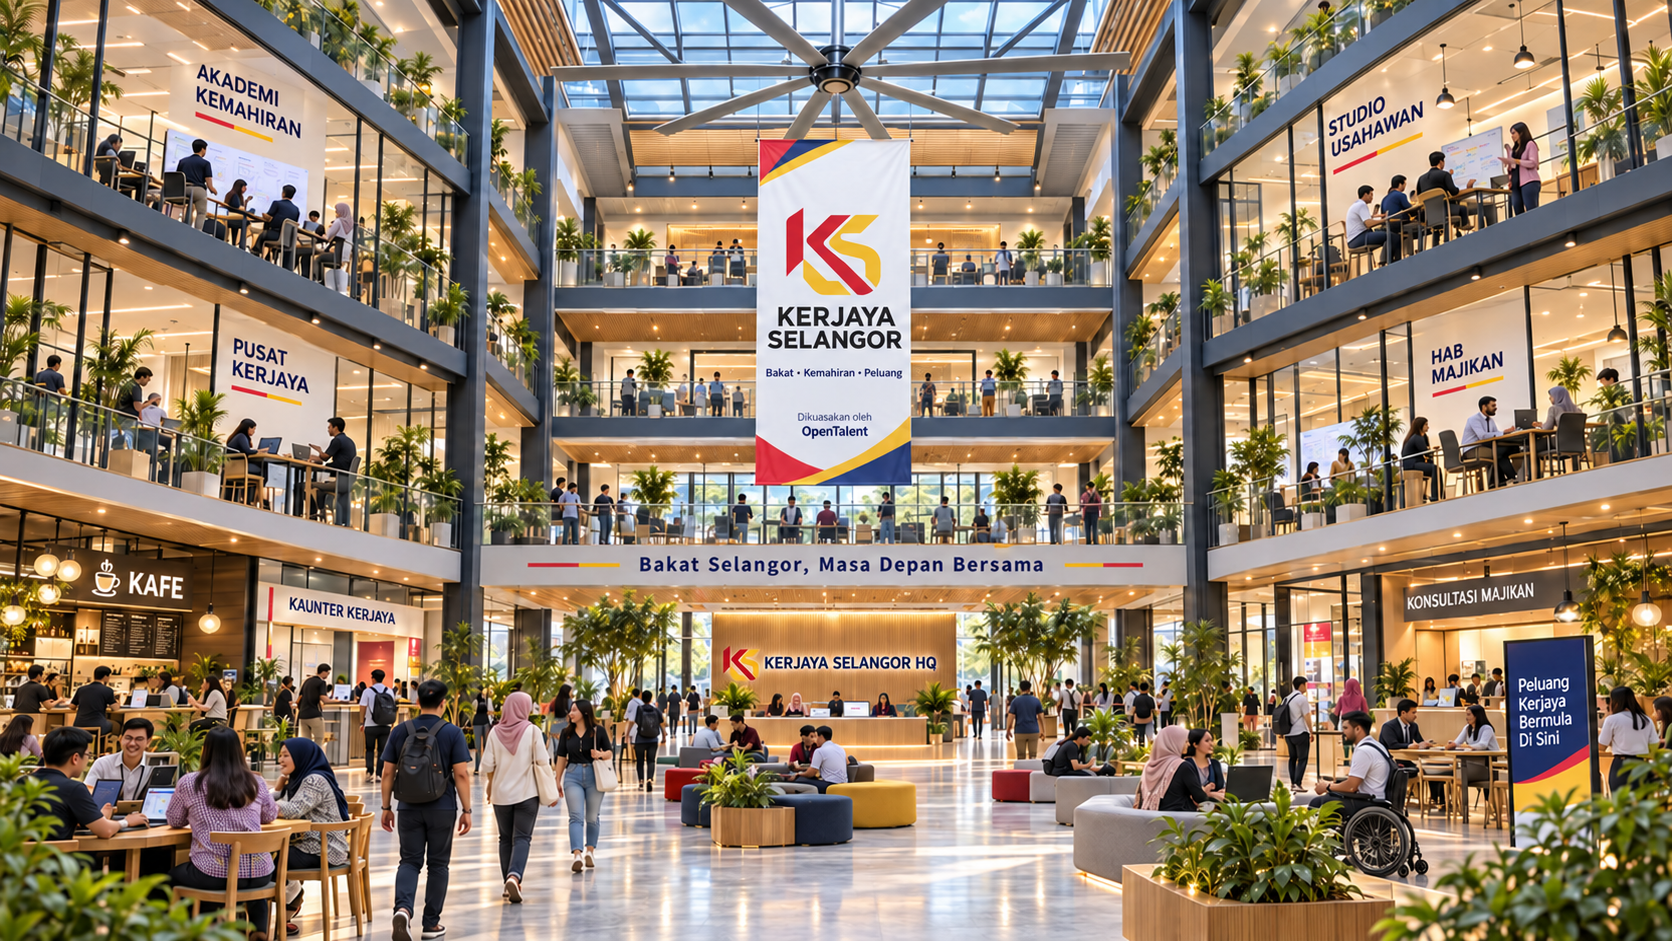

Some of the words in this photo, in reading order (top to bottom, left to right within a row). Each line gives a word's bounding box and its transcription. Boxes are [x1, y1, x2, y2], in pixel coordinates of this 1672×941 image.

[197, 64, 279, 107] AKADEMI
[196, 86, 301, 139] KEMAHIRAN
[1328, 96, 1386, 136] STUDIO
[1331, 101, 1423, 157] USAHAWAN
[777, 306, 896, 327] KERJAYA
[767, 330, 903, 350] SELANGOR
[233, 337, 288, 366] PUSAT
[1431, 343, 1464, 365] HAB
[232, 359, 310, 394] KERJAYA
[765, 368, 794, 378] Bakat
[803, 368, 856, 378] Kemahiran
[864, 368, 903, 380] Peluang
[1432, 350, 1503, 385] MAJIKAN
[797, 412, 851, 422] Dikuasakan
[852, 412, 873, 422] oleh
[801, 425, 869, 440] OpenTalent
[639, 555, 700, 573] Bakat
[708, 555, 810, 577] Selangor,
[819, 555, 871, 573] Masa
[879, 555, 944, 577] Depan
[953, 555, 1044, 573] Bersama
[128, 570, 184, 600] KAFE
[1407, 589, 1478, 611] KONSULTASI
[1481, 582, 1535, 603] MAJIKAN
[288, 596, 344, 618] KAUNTER
[346, 605, 397, 625] KERJAYA
[764, 656, 829, 670] KERJAYA
[832, 656, 911, 670] SELANGOR
[915, 656, 937, 671] HQ
[1518, 676, 1570, 693] Peluang
[1519, 694, 1566, 713] Kerjaya
[1519, 711, 1573, 730] Bermula
[1519, 732, 1533, 748] Di
[1536, 730, 1560, 746] Sini
